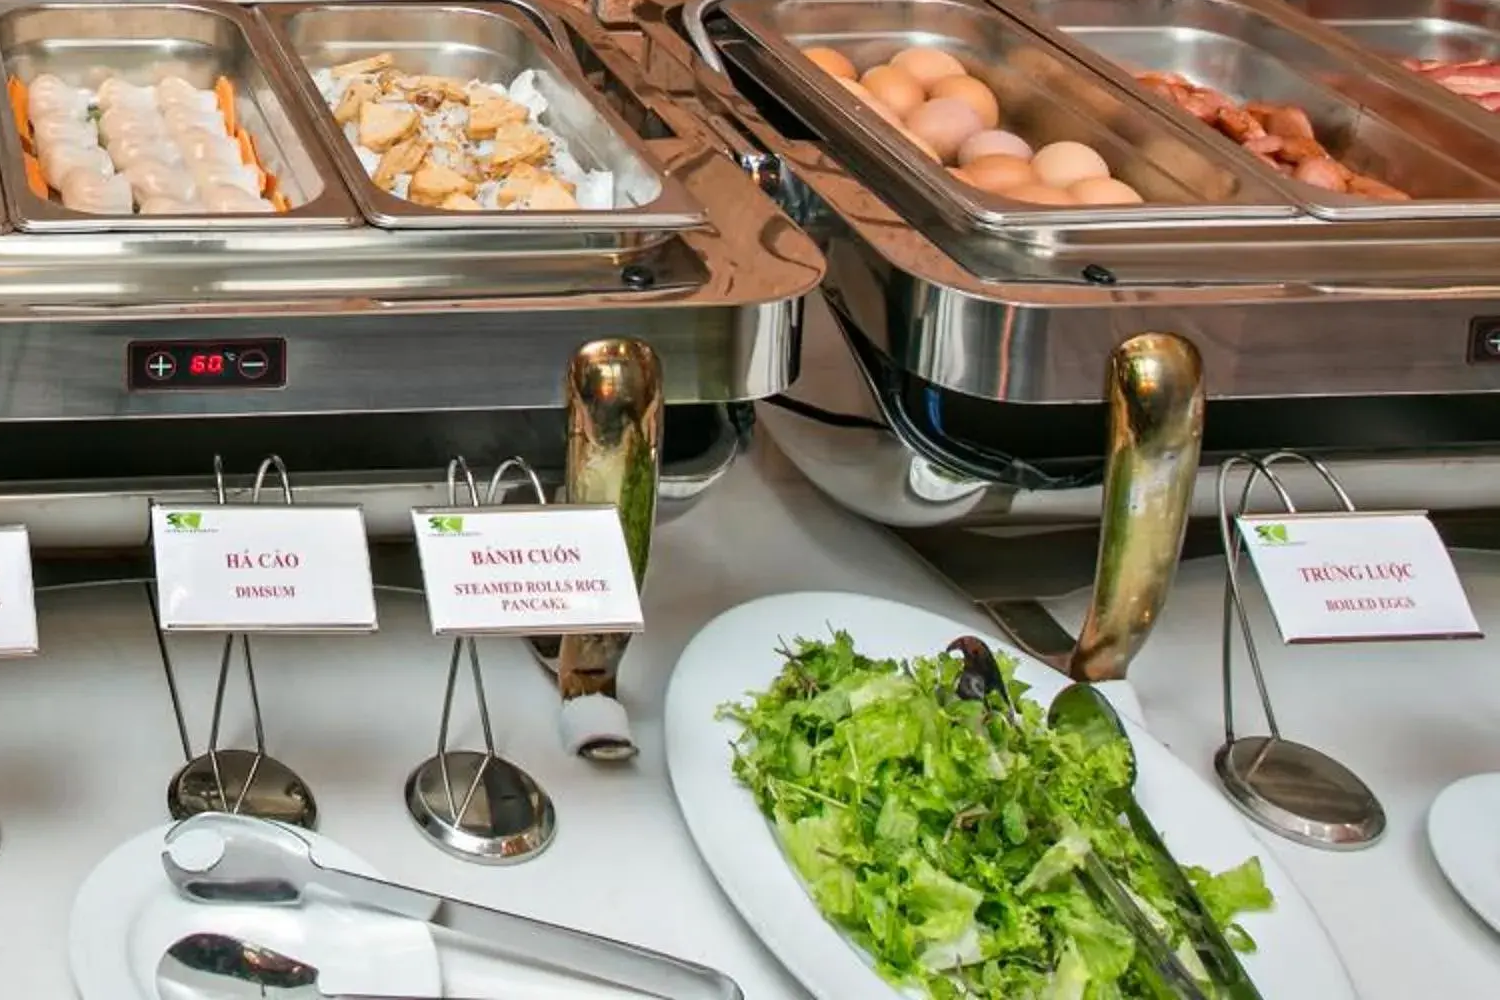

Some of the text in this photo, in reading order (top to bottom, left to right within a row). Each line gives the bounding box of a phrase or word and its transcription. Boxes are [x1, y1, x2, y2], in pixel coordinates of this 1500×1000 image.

[190, 354, 224, 375] 60
[235, 586, 296, 599] DIMSUM
[454, 579, 611, 595] STEAMED ROLLS RICE
[1325, 596, 1417, 612] BOILED EGGS
